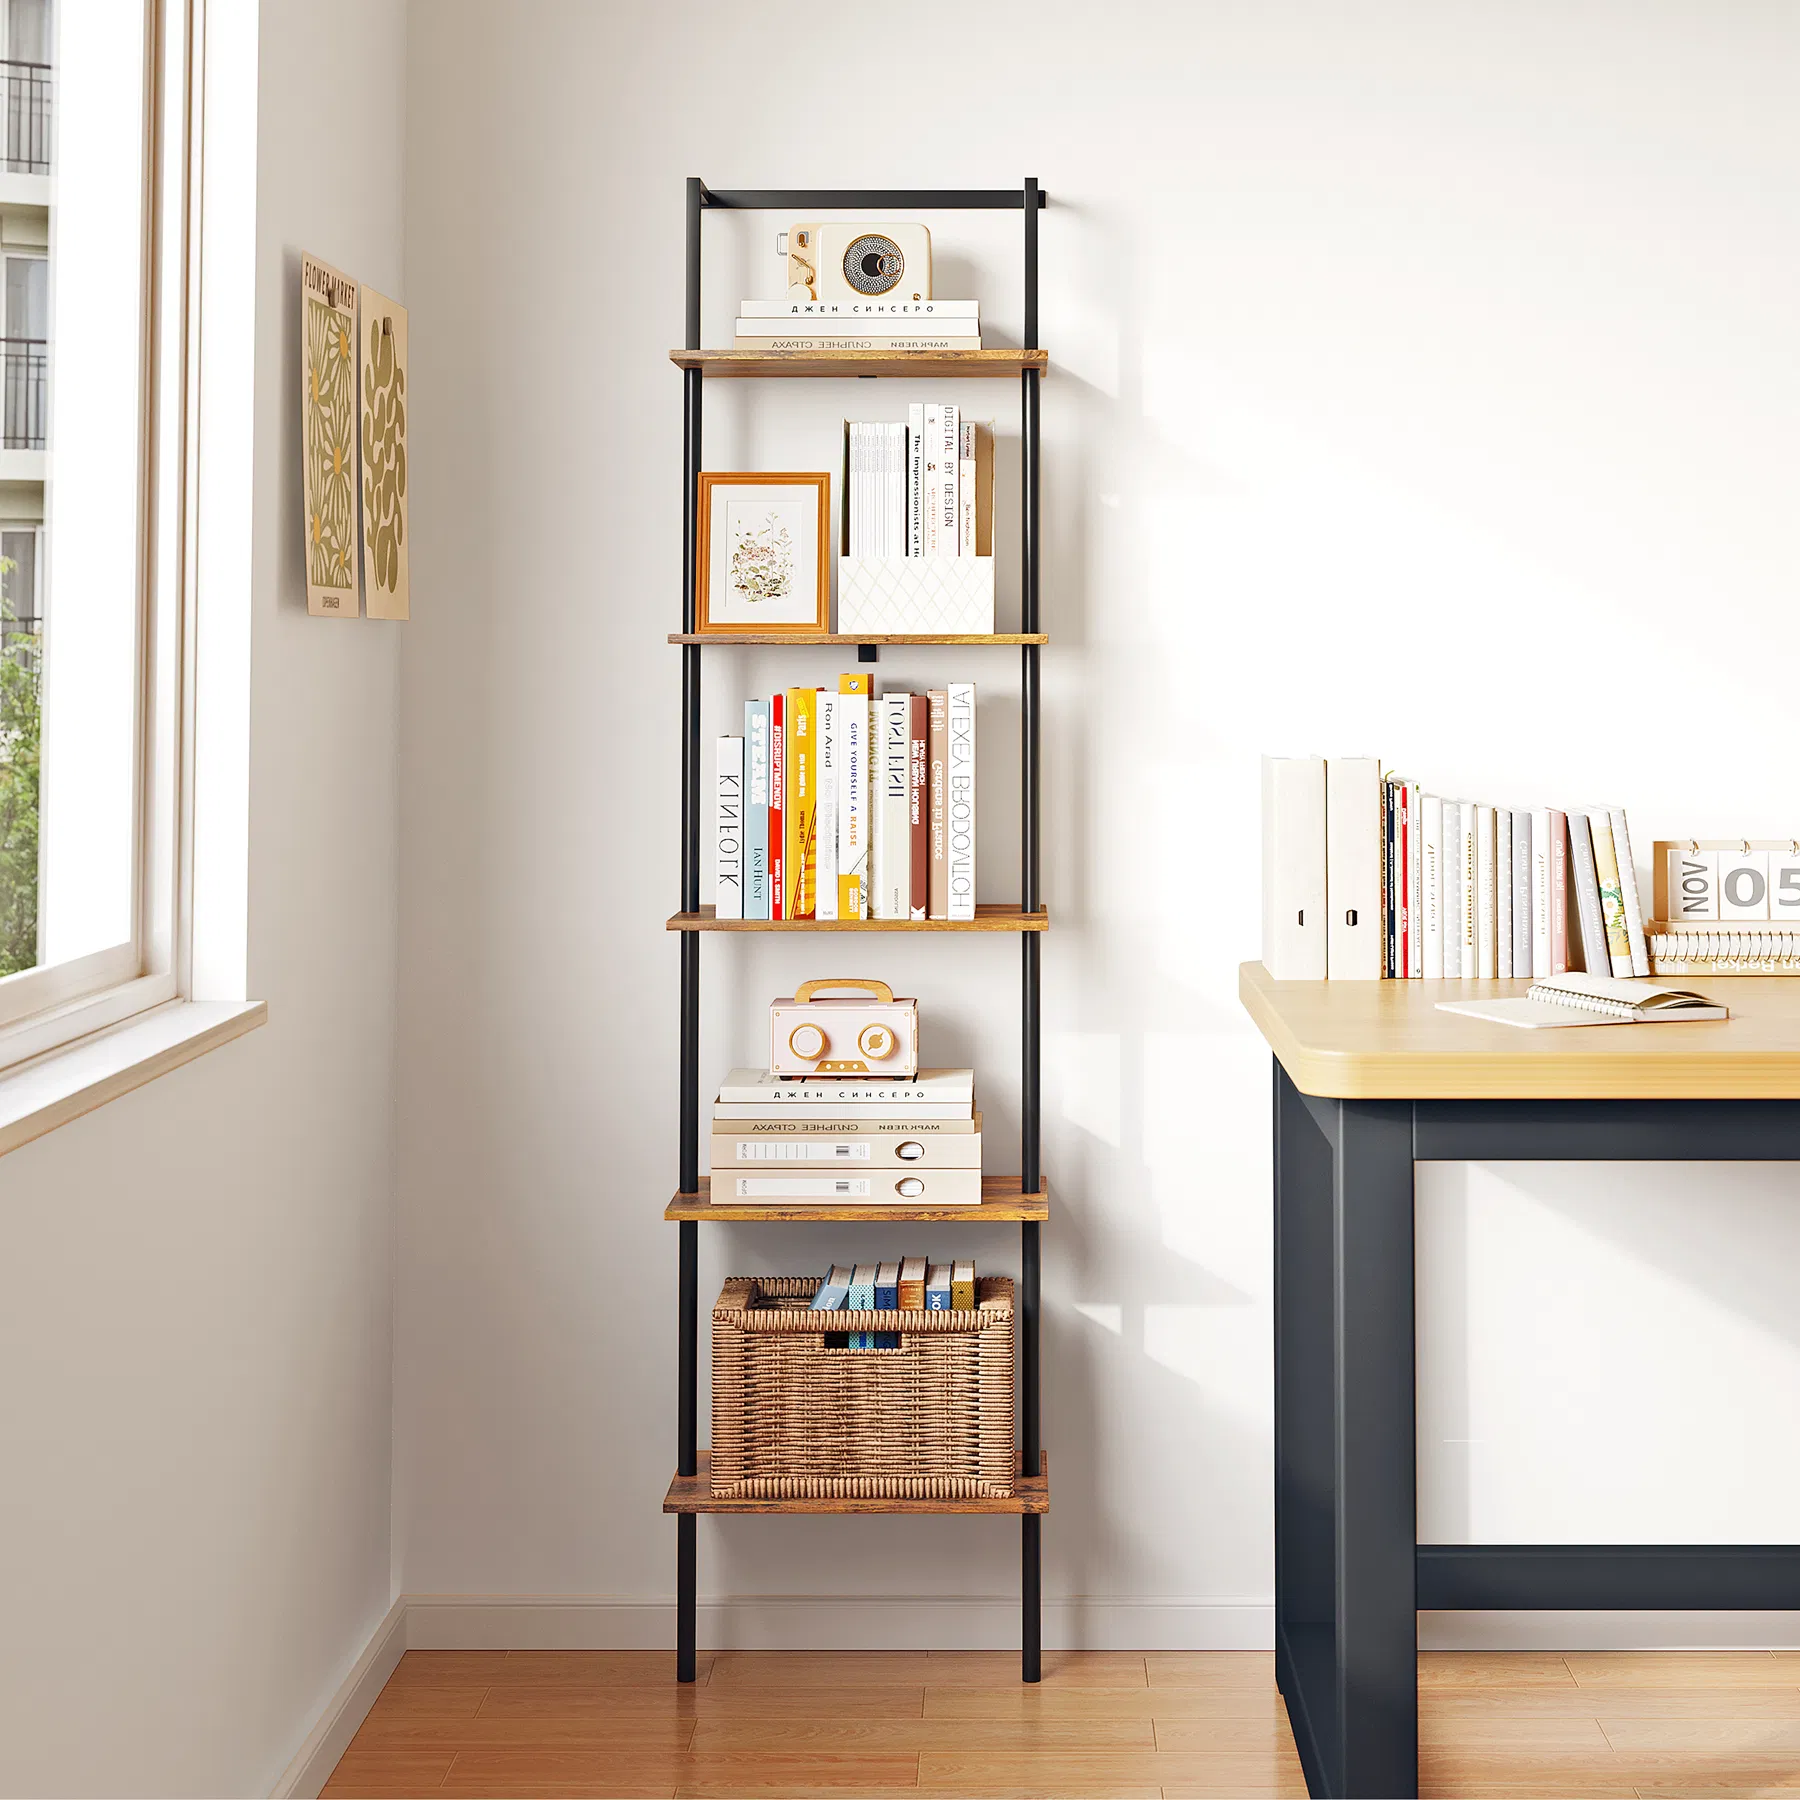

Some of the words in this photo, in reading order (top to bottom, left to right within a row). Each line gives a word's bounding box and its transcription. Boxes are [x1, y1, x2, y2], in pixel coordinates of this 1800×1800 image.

[305, 261, 330, 297] FLOWER
[791, 305, 839, 313] ДЖЕН
[853, 305, 934, 313] СИНСЕРО
[913, 434, 921, 452] The
[944, 406, 954, 454] DIGITAL
[944, 462, 954, 475] BY
[912, 456, 921, 531] Impressionists
[944, 483, 954, 528] DESIGN
[913, 533, 921, 545] at
[796, 714, 807, 737] Paris
[824, 702, 833, 733] Ron
[849, 722, 858, 747] GIVE
[750, 713, 767, 805] STEAM
[824, 735, 833, 768] Arad
[773, 725, 783, 810] #DISRUPTMENOW
[849, 750, 858, 802] YOURSELF
[849, 816, 858, 847] RAISE
[1682, 861, 1709, 912] NOV
[1711, 959, 1775, 972] Berkel
[773, 1091, 823, 1099] ДЖЕН
[838, 1091, 925, 1099] СИНСЕРО
